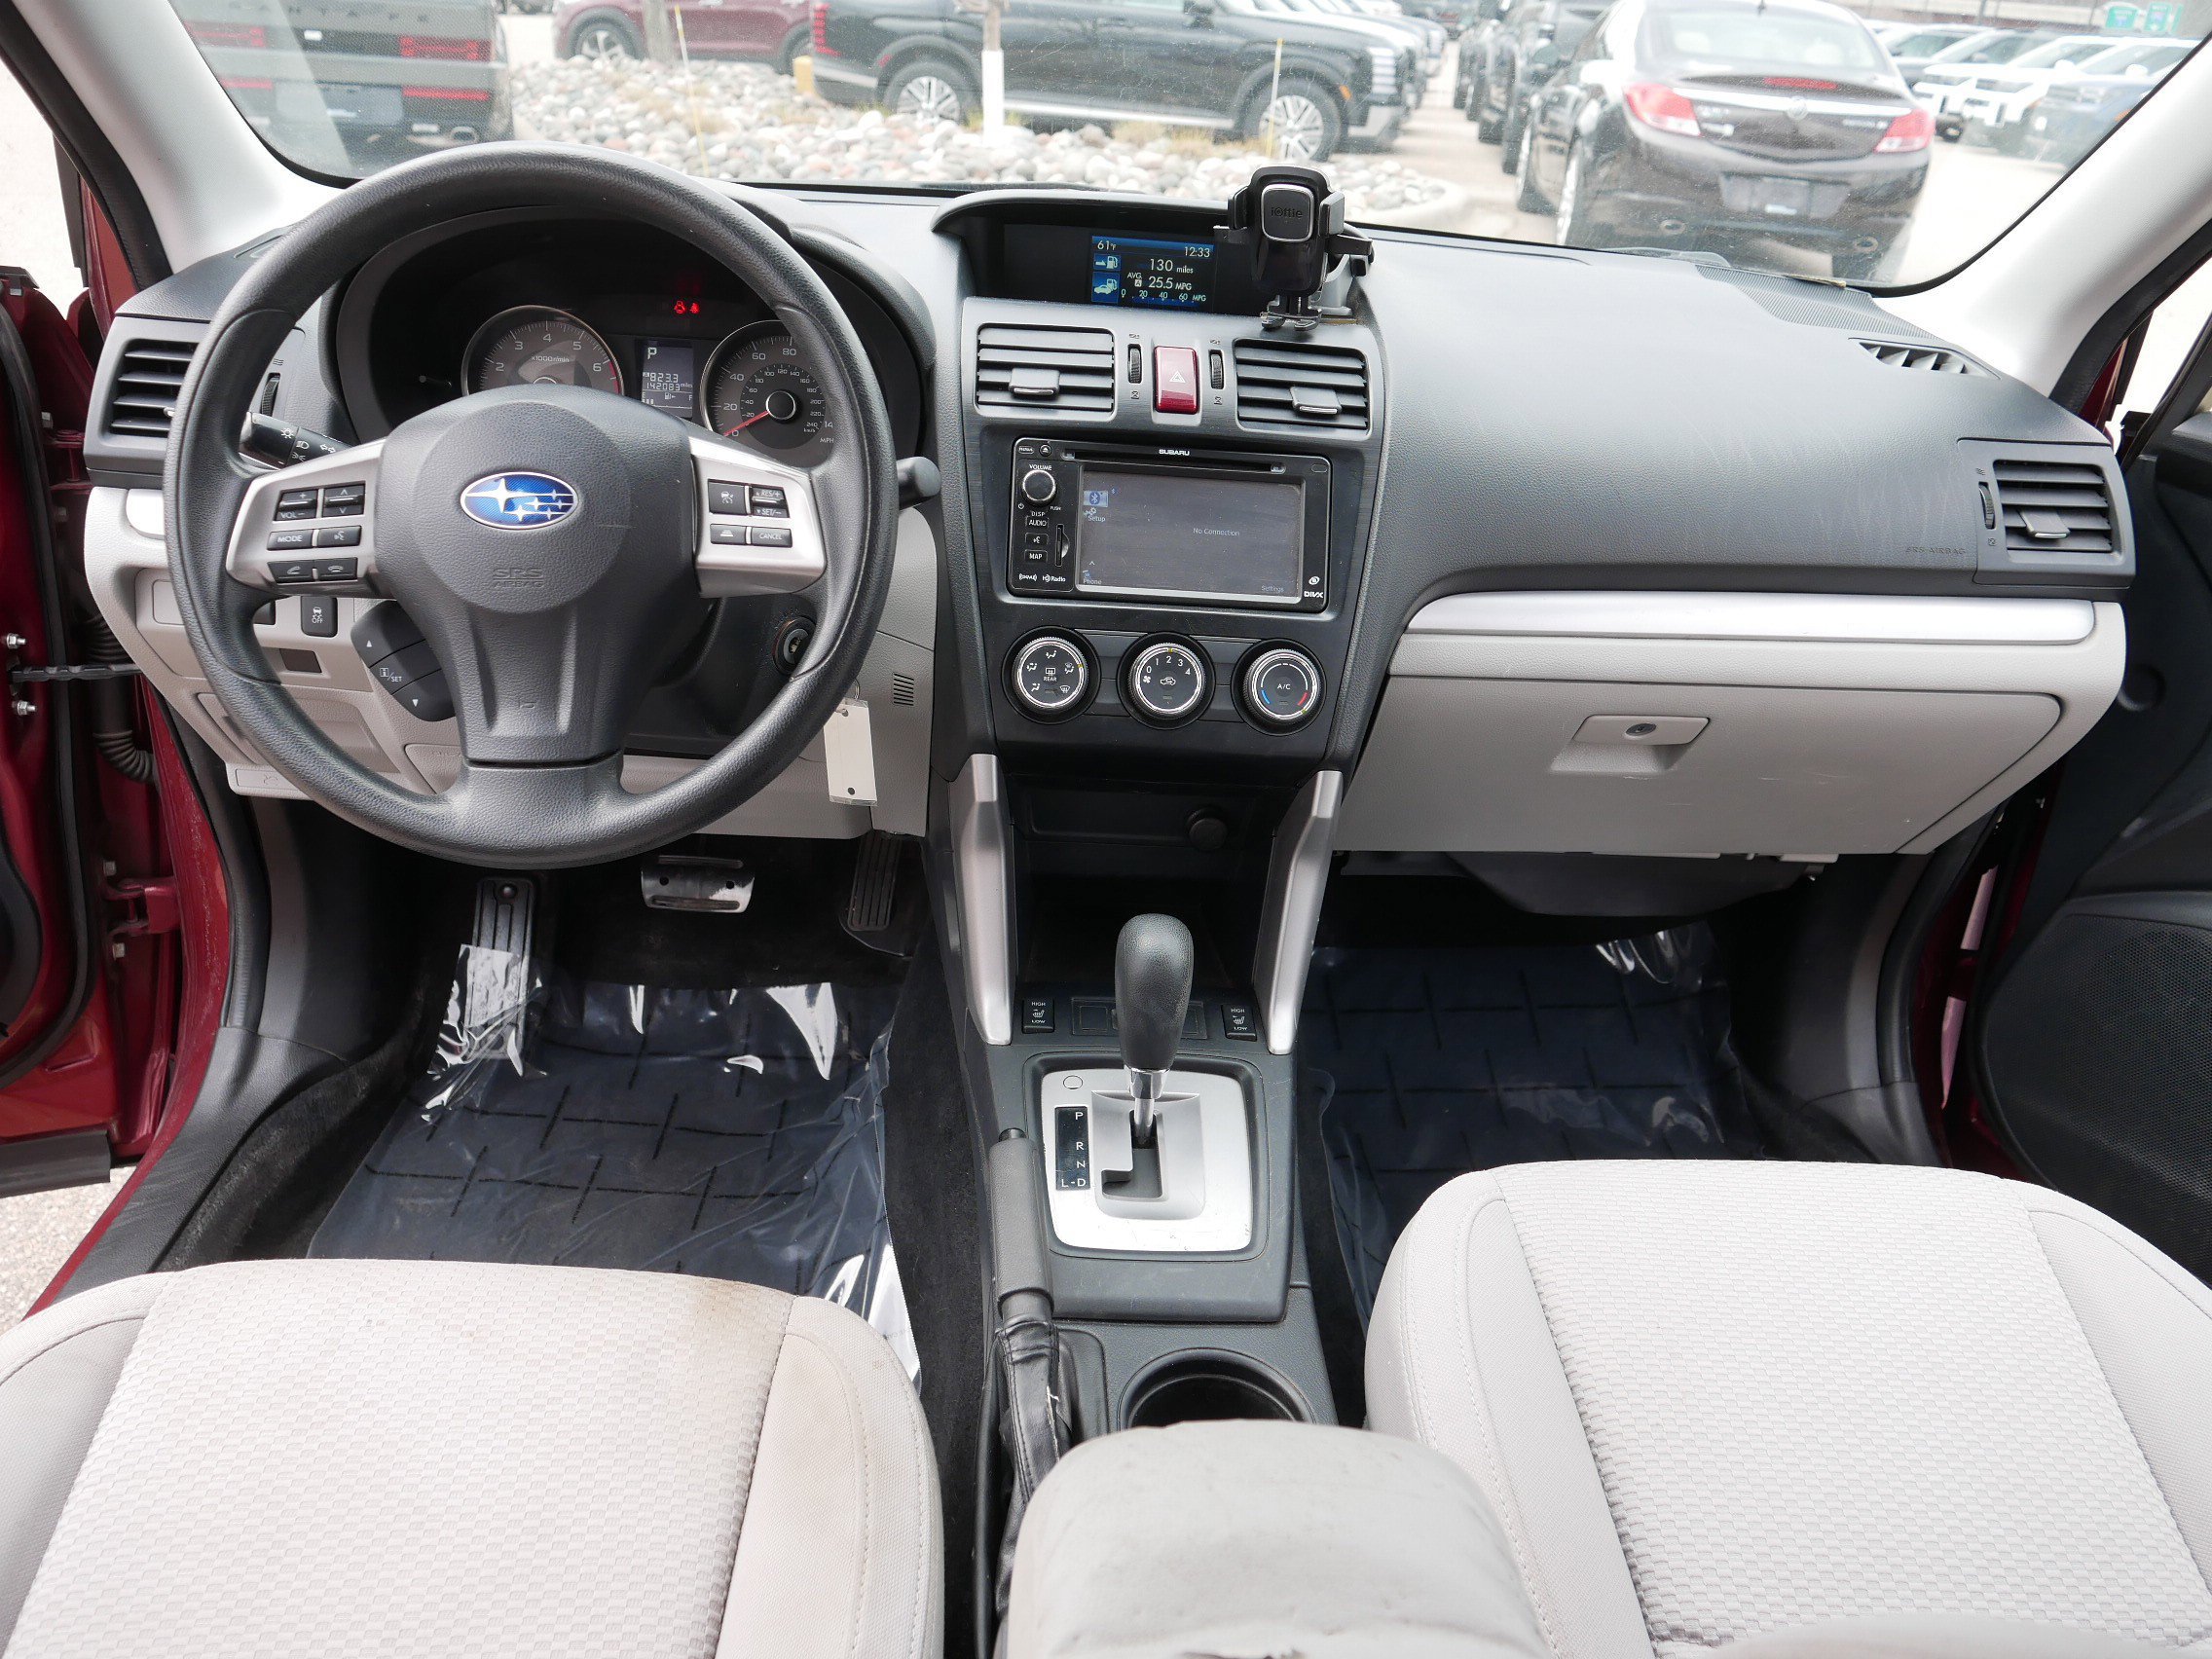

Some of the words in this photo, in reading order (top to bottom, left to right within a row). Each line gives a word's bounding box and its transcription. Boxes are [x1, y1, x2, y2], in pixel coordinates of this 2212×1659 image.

[1184, 246, 1210, 258] 12:33
[1150, 258, 1173, 272] 130
[1176, 265, 1194, 274] miles
[1148, 276, 1173, 289] 25.5
[1175, 282, 1193, 291] MPG
[542, 333, 552, 343] 4
[514, 341, 524, 350] 3
[572, 341, 582, 350] 5
[647, 347, 657, 359] P
[496, 362, 504, 372] 2
[592, 362, 602, 372] 6
[649, 372, 679, 383] 823.3
[729, 373, 744, 382] 40
[646, 383, 681, 391] 142083
[1203, 528, 1240, 536] Connection
[276, 535, 303, 543] MODE
[493, 567, 545, 578] SRS
[1165, 655, 1172, 664] 2
[1177, 658, 1184, 667] 3
[1146, 665, 1152, 674] 0
[1184, 667, 1191, 676] 4
[1075, 1111, 1084, 1121] P
[1076, 1141, 1085, 1151] R
[1076, 1160, 1086, 1169] N
